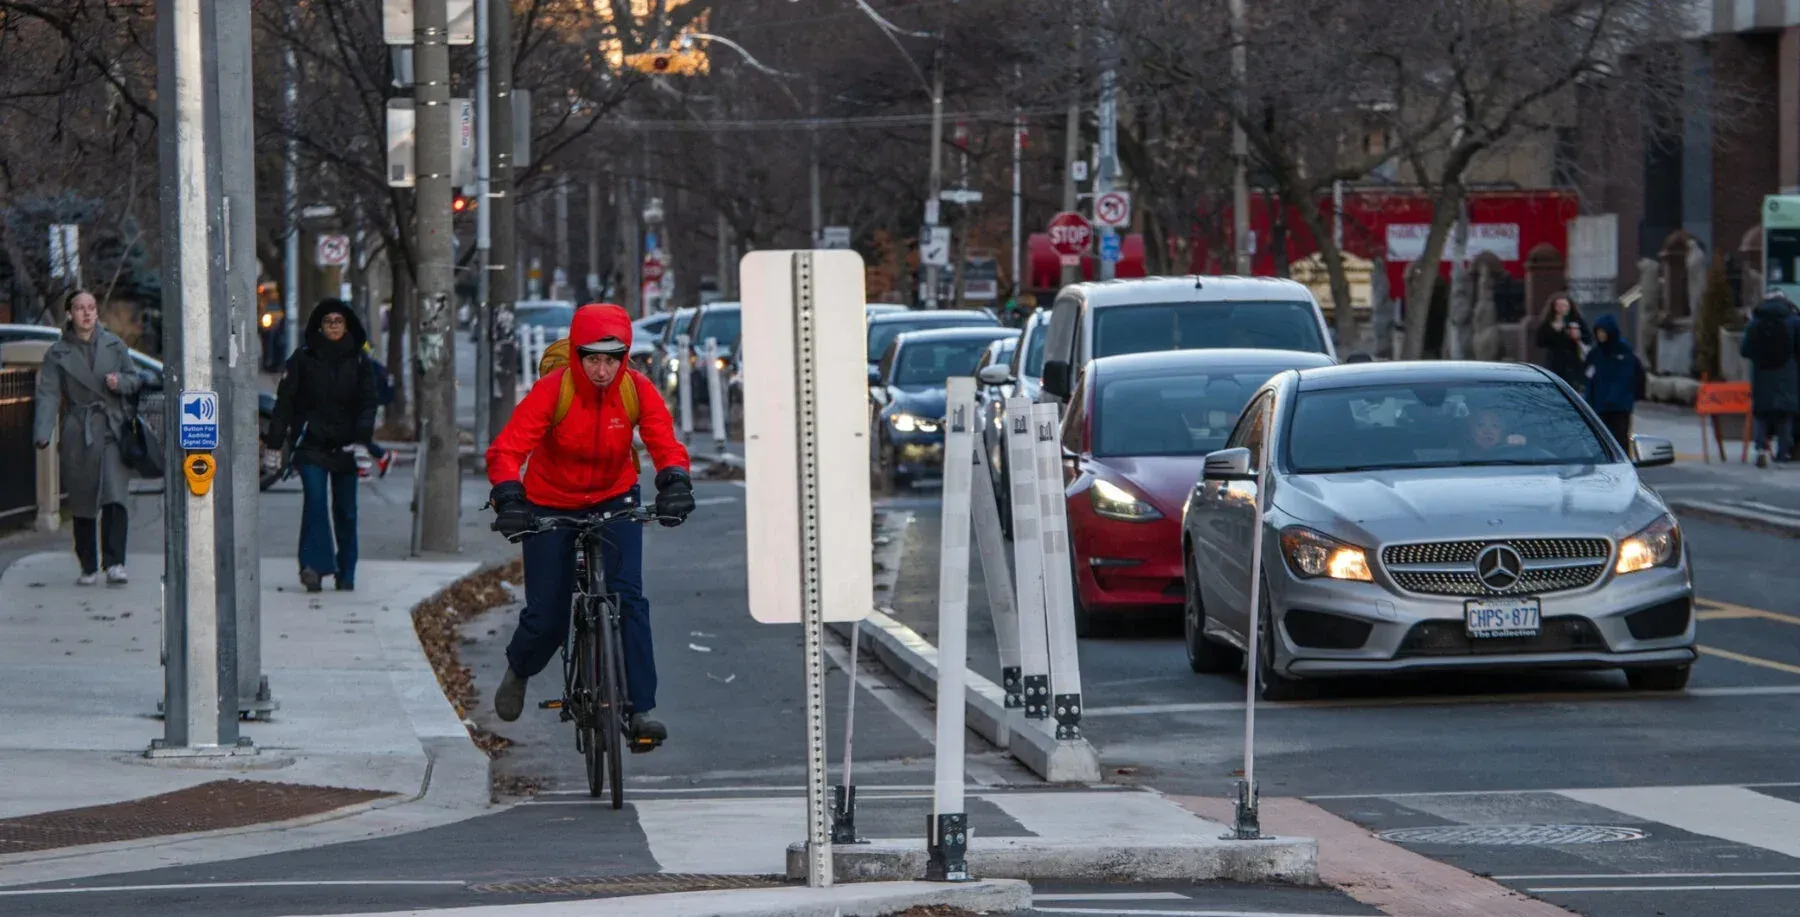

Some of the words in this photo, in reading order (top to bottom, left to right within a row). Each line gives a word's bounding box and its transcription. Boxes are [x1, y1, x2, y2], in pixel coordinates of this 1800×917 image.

[1051, 225, 1089, 244] STOP
[1469, 609, 1504, 628] CHPS
[1512, 607, 1537, 626] 877
